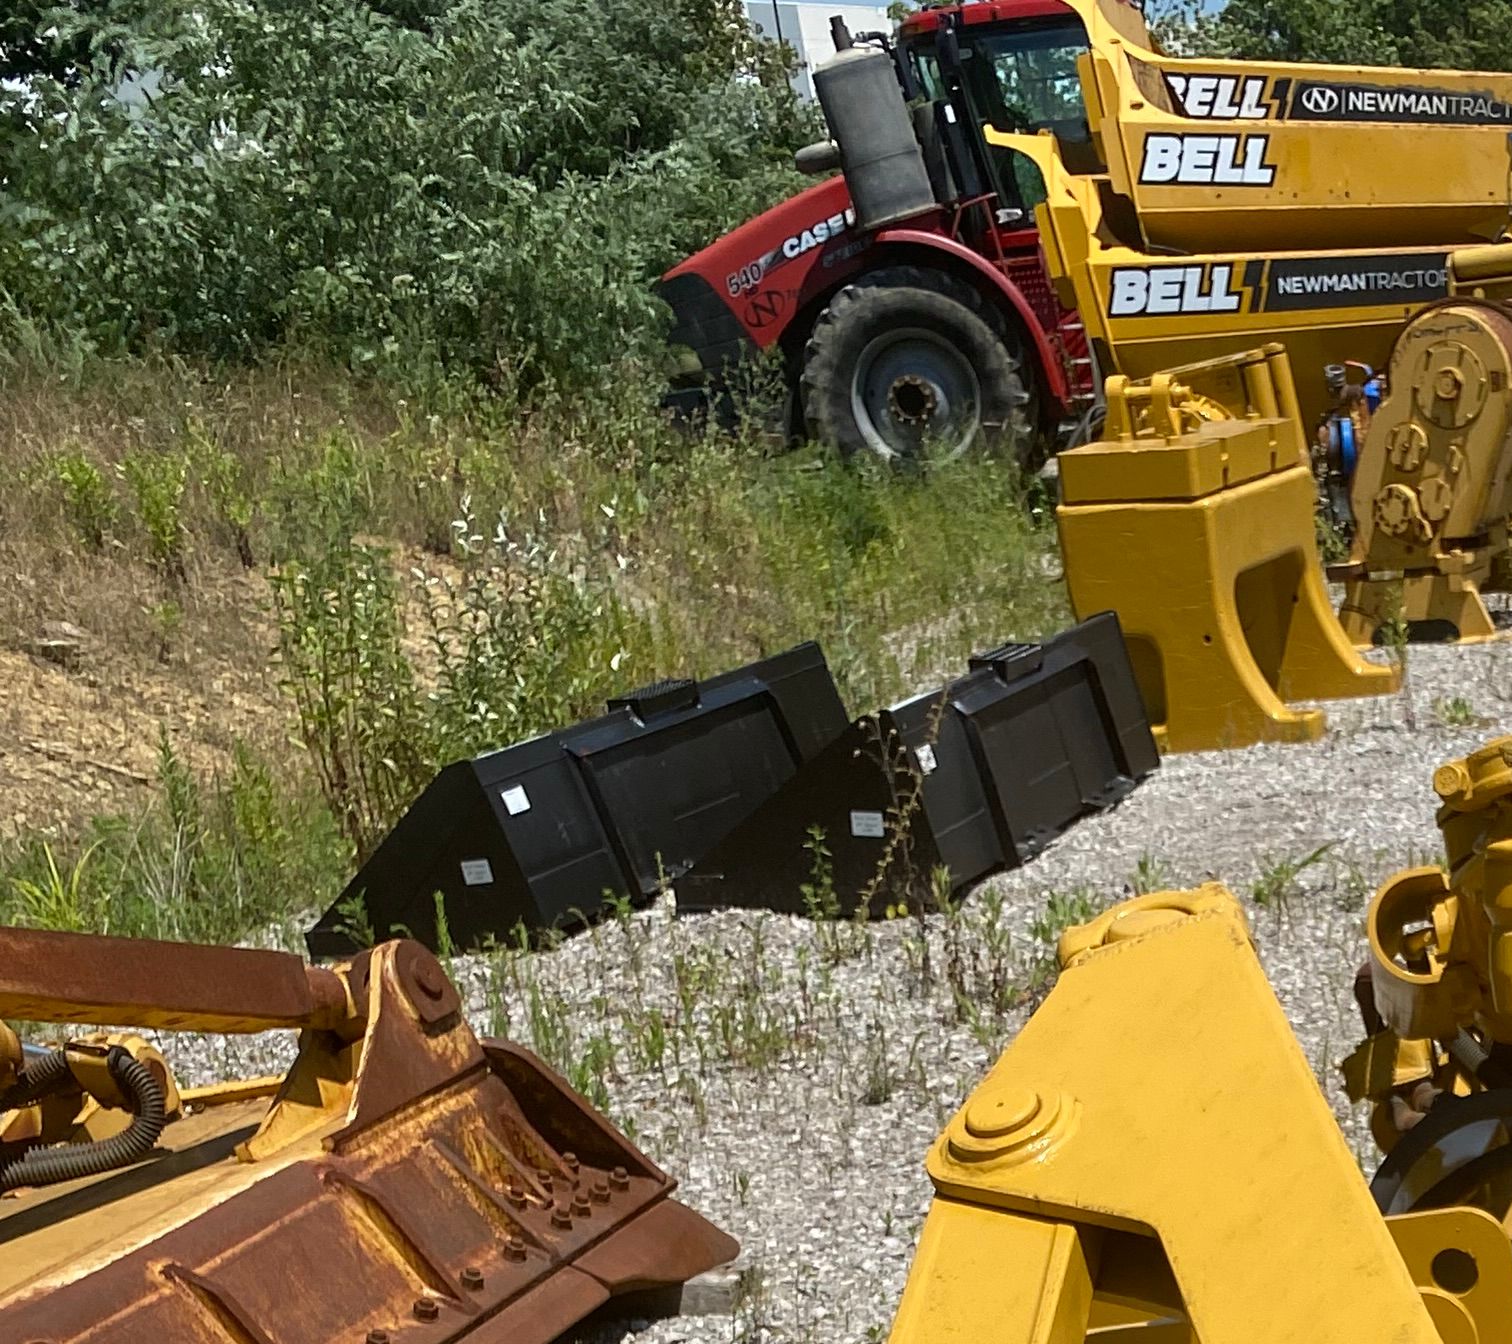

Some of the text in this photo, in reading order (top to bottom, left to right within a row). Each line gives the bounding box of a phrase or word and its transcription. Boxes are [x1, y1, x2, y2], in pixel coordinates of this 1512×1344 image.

[1167, 75, 1270, 119] ELL
[1141, 135, 1274, 185] BELL
[782, 213, 846, 259] CASE
[727, 262, 765, 297] 540
[1110, 265, 1240, 315] BELL
